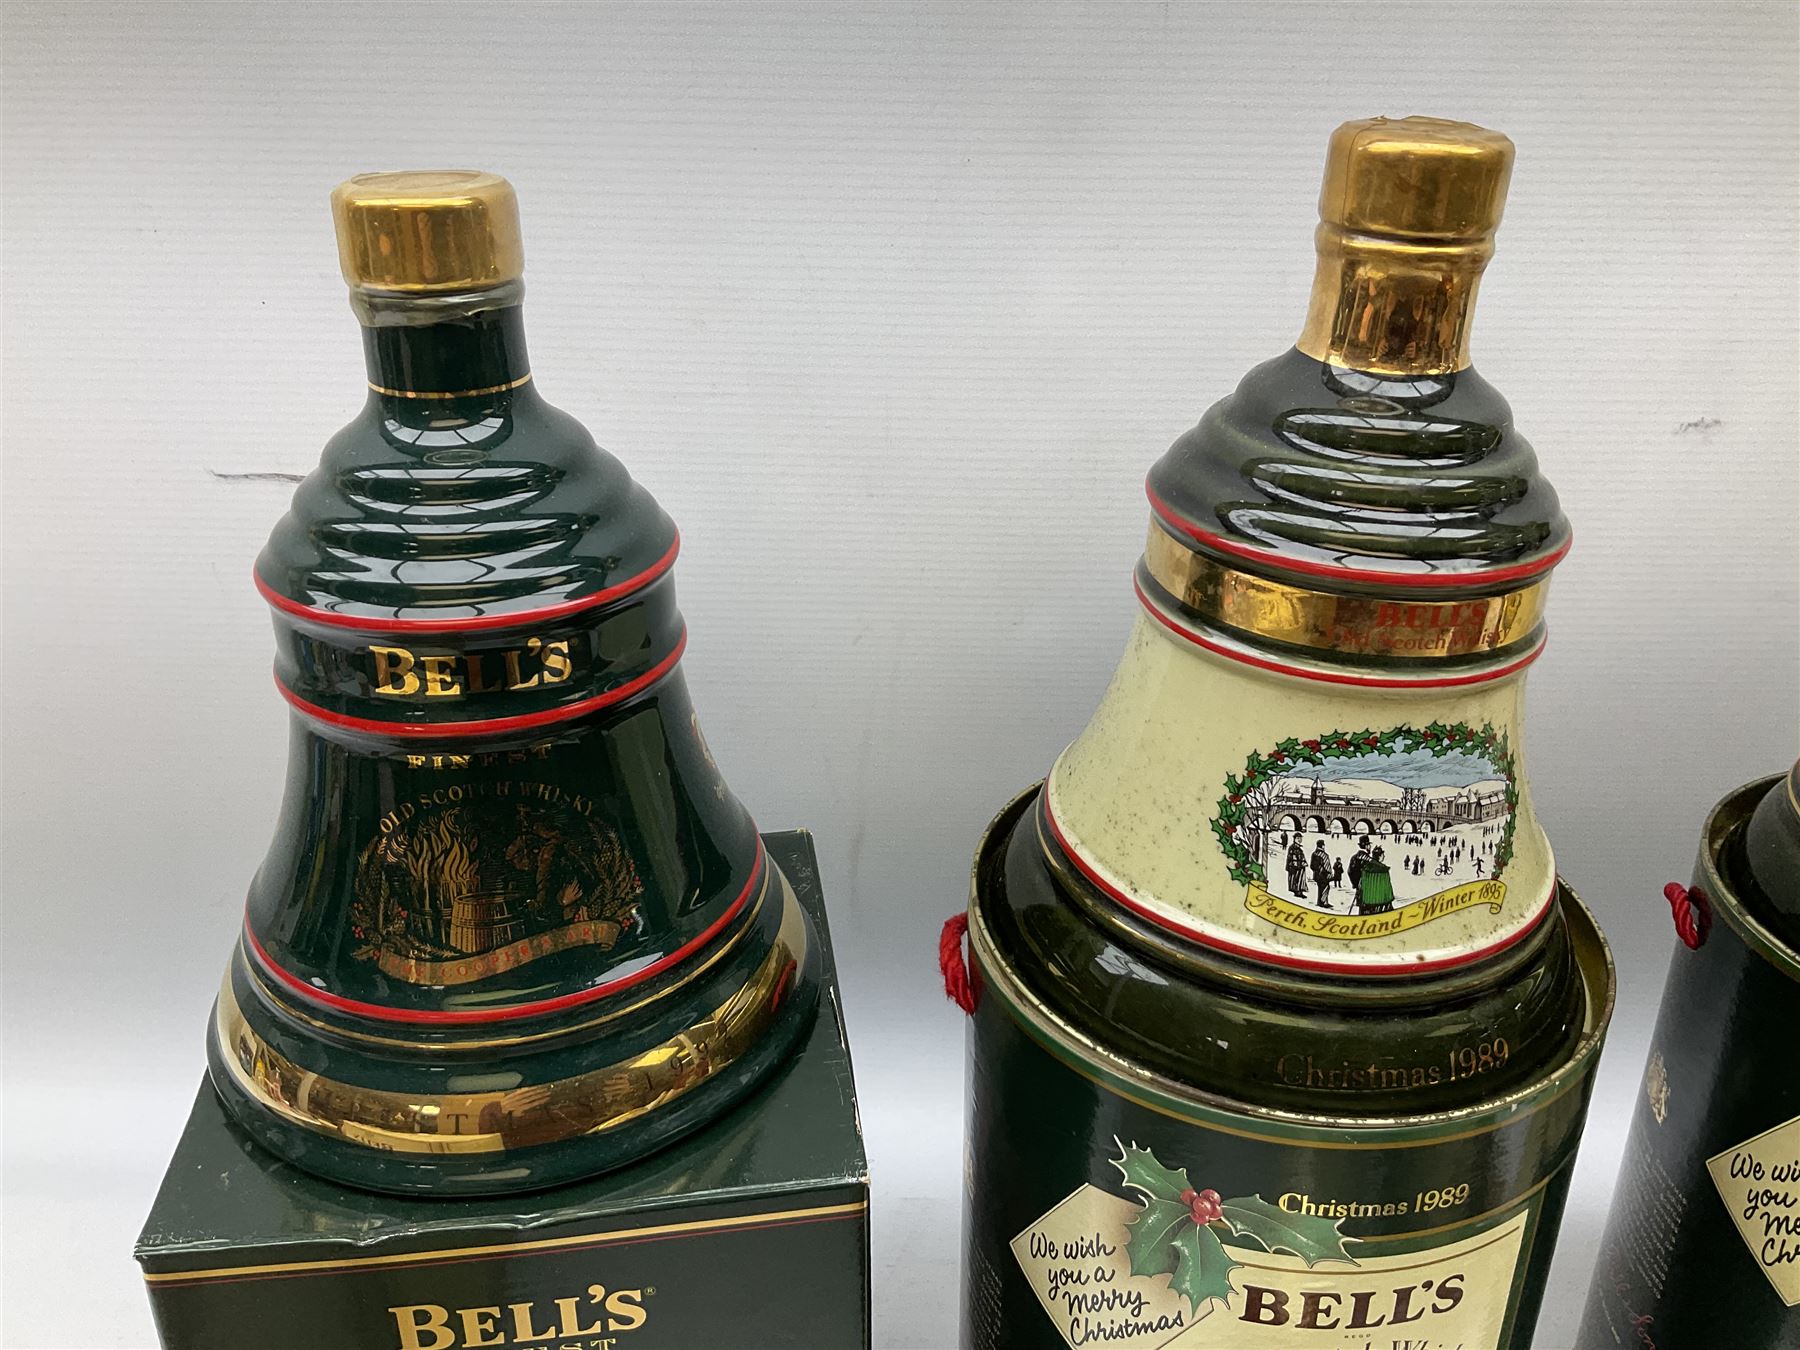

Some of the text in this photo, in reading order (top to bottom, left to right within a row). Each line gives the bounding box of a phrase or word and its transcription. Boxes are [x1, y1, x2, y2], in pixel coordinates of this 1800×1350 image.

[368, 637, 573, 696] BELL'S
[379, 802, 416, 834] OLD
[1311, 910, 1403, 937] Scotland
[1478, 883, 1502, 900] 1895
[1275, 1037, 1510, 1089] Christmas 1989
[1730, 1152, 1766, 1181] We
[1278, 1183, 1470, 1217] Christmas 1989
[1743, 1188, 1798, 1220] you
[1030, 1232, 1116, 1260] We wish
[1048, 1266, 1115, 1300] you a
[387, 1284, 647, 1350] BELL'S
[1238, 1273, 1465, 1330] BELL'S
[1070, 1310, 1184, 1346] Christmas
